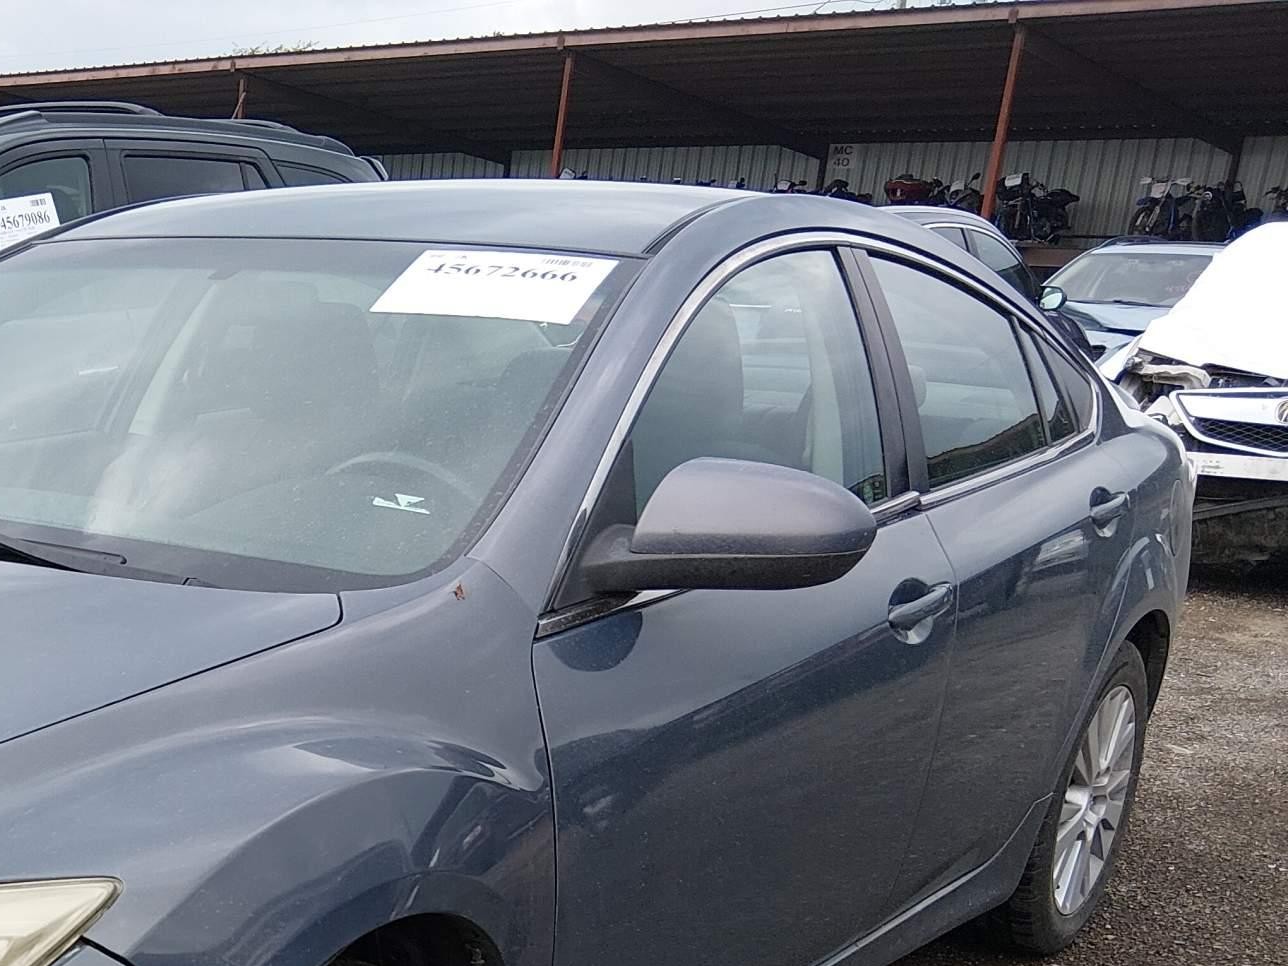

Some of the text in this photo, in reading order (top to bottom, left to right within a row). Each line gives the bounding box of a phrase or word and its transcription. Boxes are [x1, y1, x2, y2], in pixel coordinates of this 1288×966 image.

[833, 145, 854, 155] MC
[0, 209, 51, 230] 45679086
[427, 262, 577, 281] 45672666
